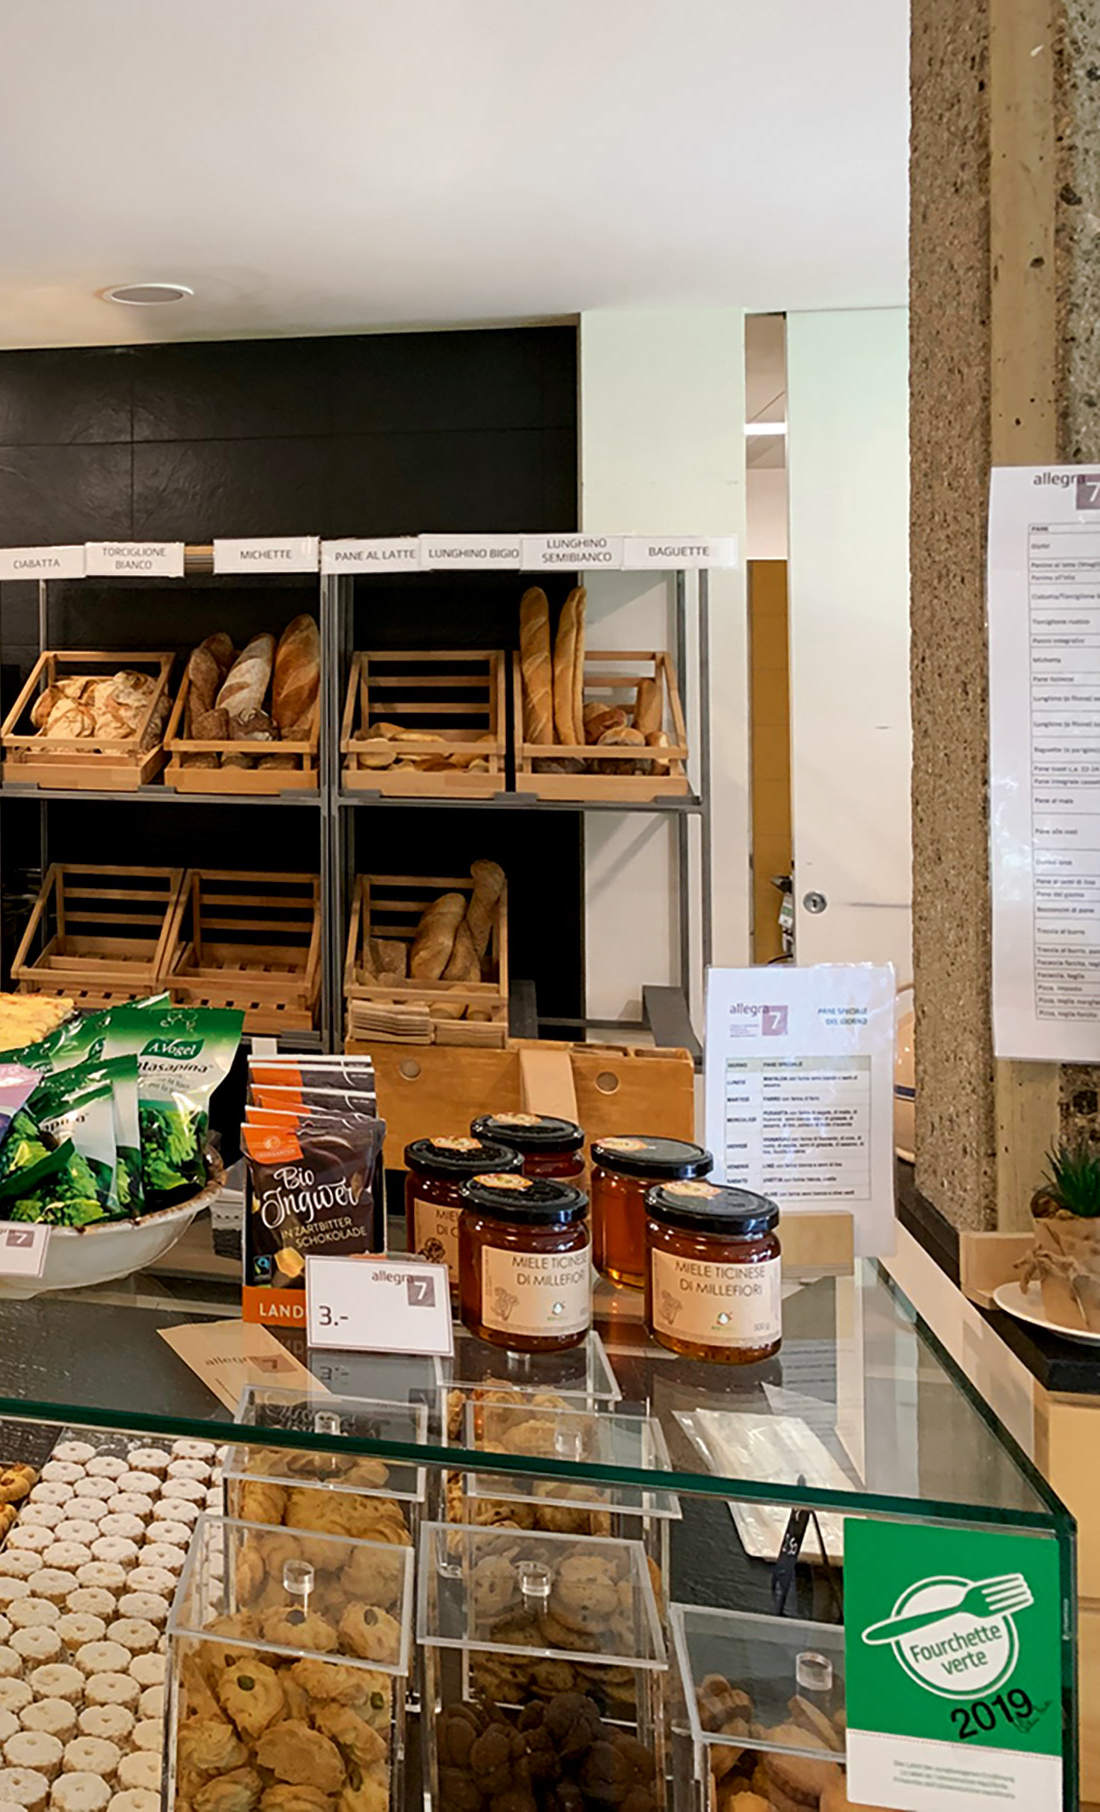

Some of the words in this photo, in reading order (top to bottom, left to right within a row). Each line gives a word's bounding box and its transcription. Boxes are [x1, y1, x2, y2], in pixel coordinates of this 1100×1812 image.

[1033, 472, 1085, 488] allegra
[546, 538, 607, 549] LUNGHINO
[102, 547, 167, 557] TORCIGLIONE
[240, 549, 292, 560] MICHETTE
[334, 551, 364, 561] PANE
[367, 550, 381, 560] AL
[383, 549, 416, 560] LATTE
[428, 548, 487, 559] LUNGHINO
[490, 548, 520, 559] BIGIO
[542, 552, 613, 563] SEMIBIANCO
[648, 546, 710, 557] BAGUETTE
[13, 558, 61, 569] CIABATTA
[115, 560, 152, 570] BIANCO
[729, 1004, 769, 1017] allegra
[769, 1012, 781, 1030] 7
[273, 1166, 315, 1190] Bio
[295, 1216, 353, 1237] ZARTBITTER
[436, 1225, 446, 1235] DI
[14, 1233, 28, 1244] 7
[295, 1226, 367, 1248] SCHOKOLADE
[512, 1256, 548, 1269] MIELE
[675, 1261, 711, 1277] MIELE
[715, 1265, 765, 1279] TICINESE
[372, 1270, 414, 1285] allegra
[517, 1273, 530, 1285] DI
[414, 1281, 427, 1300] 7
[680, 1278, 692, 1291] DI
[696, 1283, 763, 1297] MILLEFIORI
[909, 1624, 1002, 1663] Fourchette
[941, 1651, 988, 1675] verte
[951, 1688, 1033, 1739] 2019
